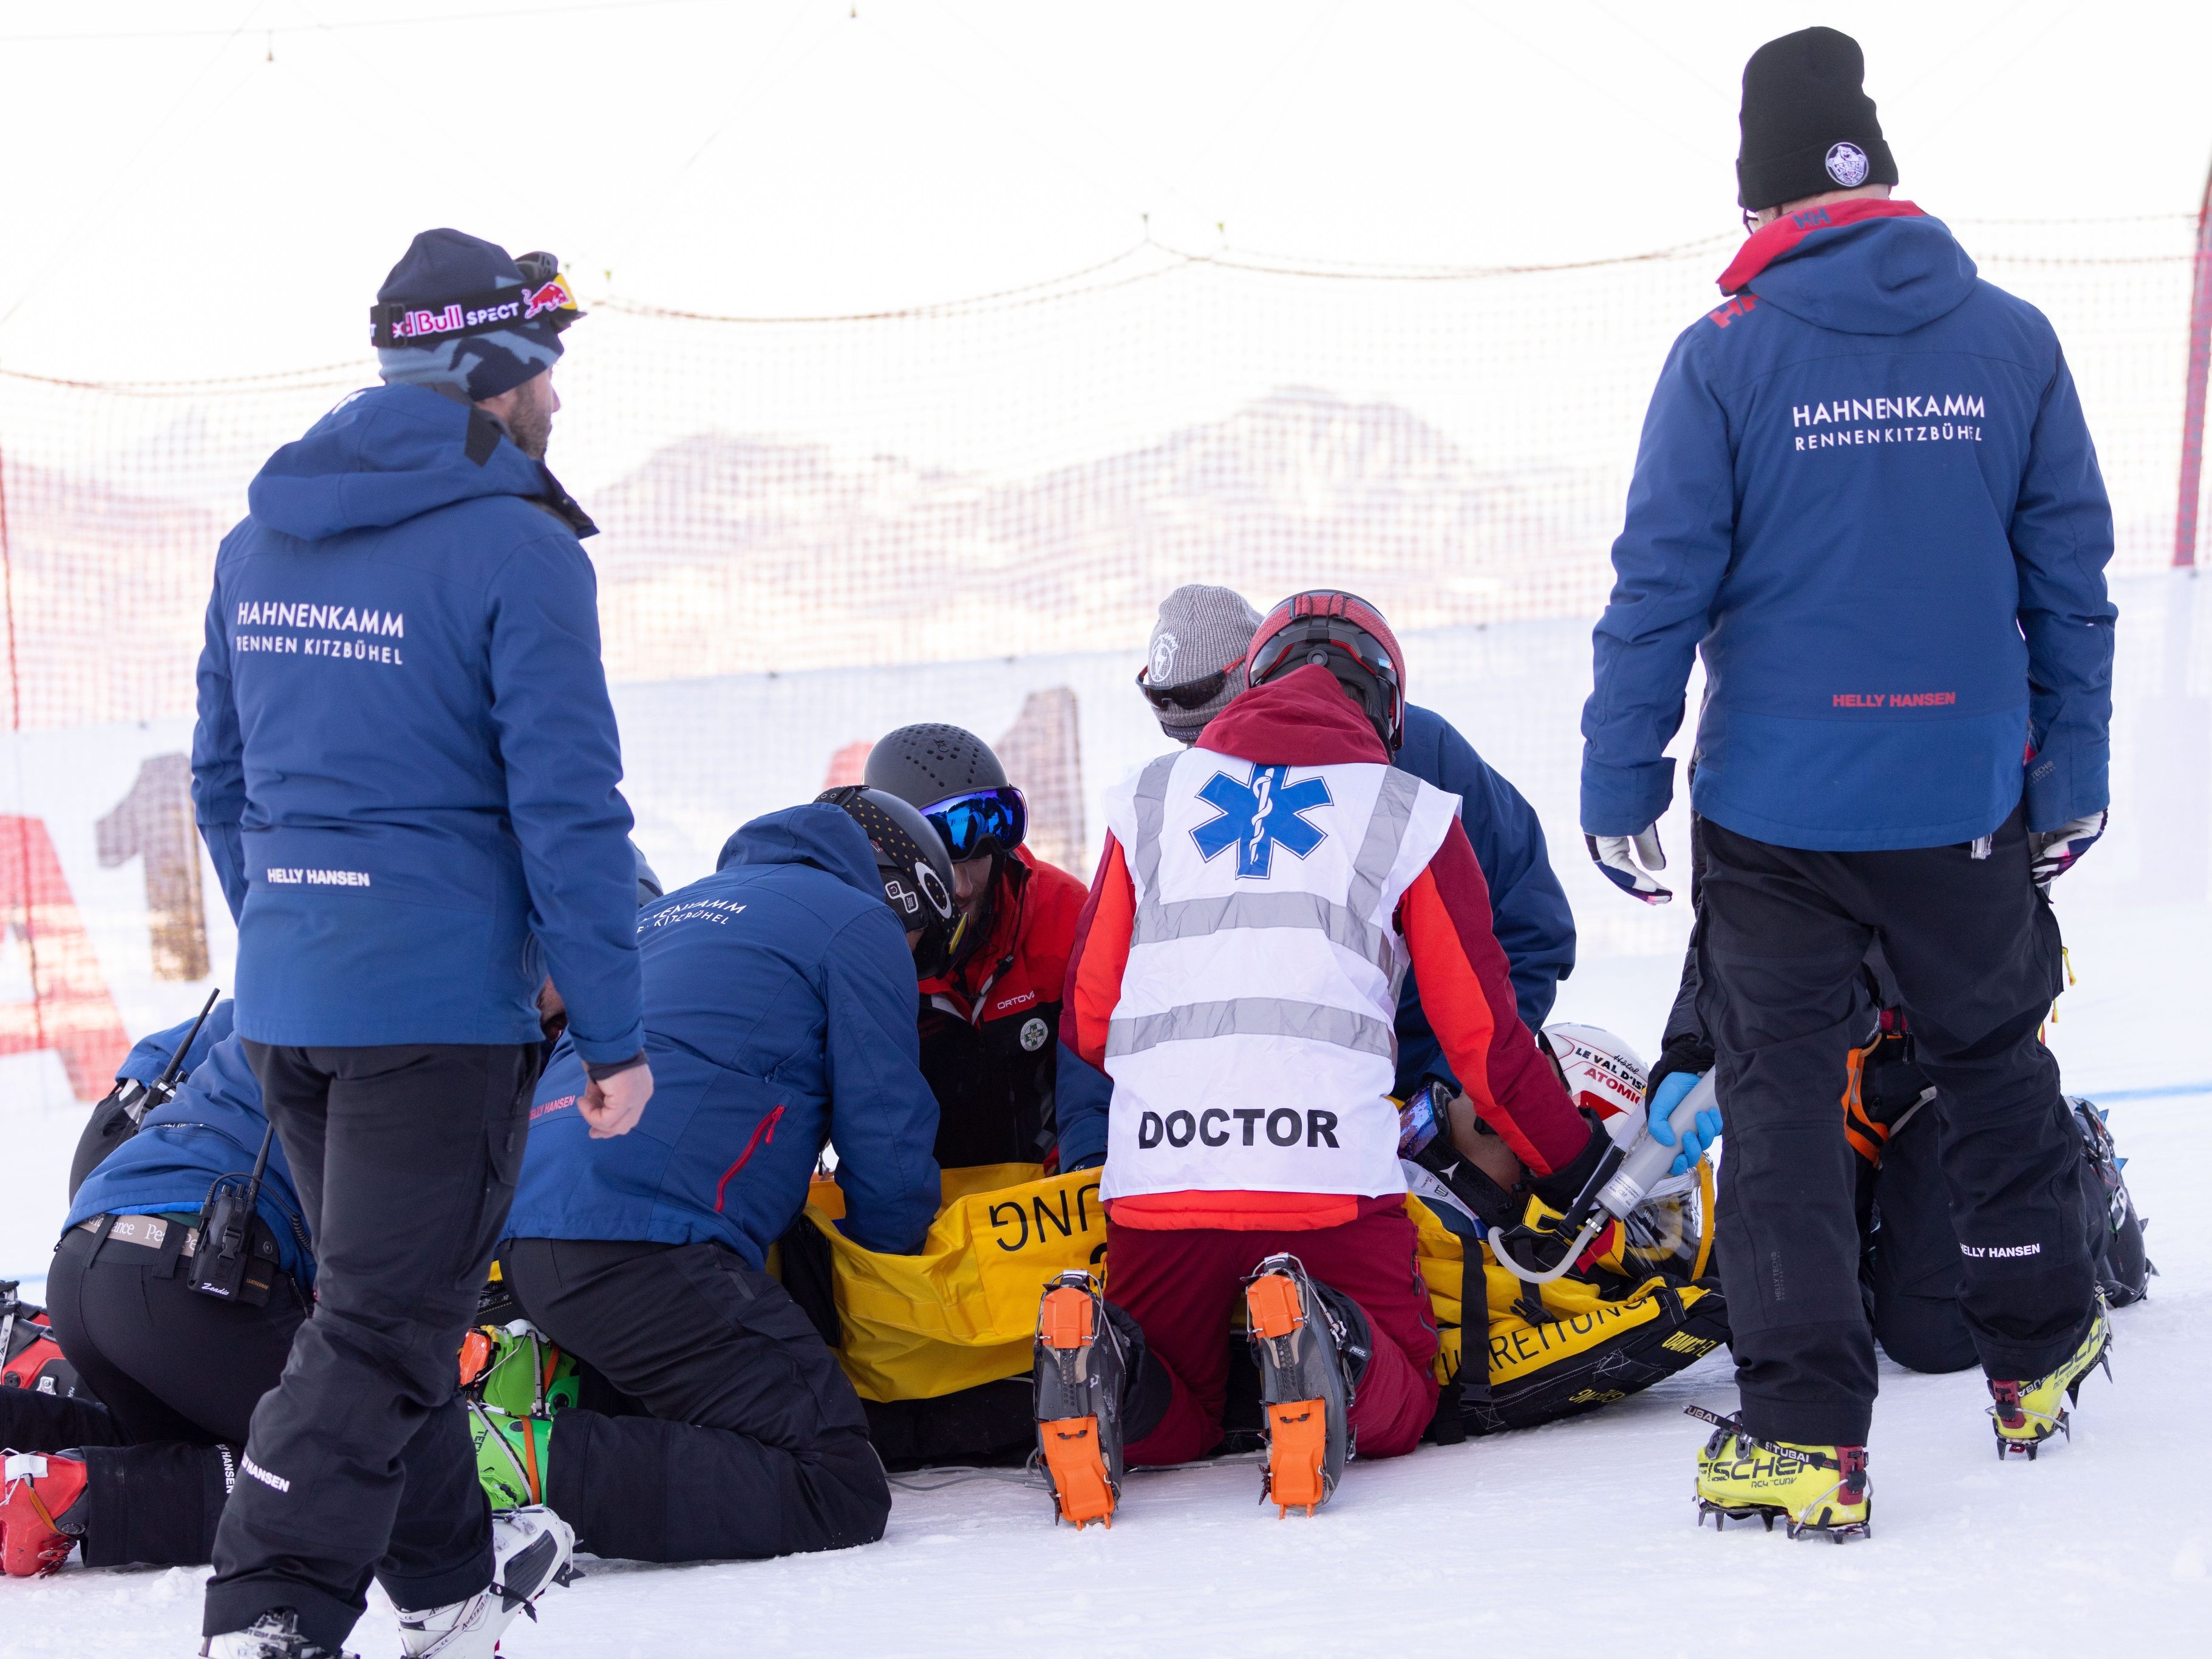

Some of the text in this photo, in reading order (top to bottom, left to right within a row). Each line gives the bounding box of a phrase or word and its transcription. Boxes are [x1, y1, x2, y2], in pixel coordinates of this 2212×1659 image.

[415, 304, 464, 336] Bull
[466, 302, 520, 325] SPECT
[1793, 394, 1985, 428] HAHNENKAMM
[237, 601, 404, 638] HAHNENKAMM
[236, 635, 403, 665] RENNEN KITZBÜHEL
[1833, 692, 1956, 707] HELLY HANSEN
[267, 868, 370, 887] HELLY HANSEN
[1575, 1048, 1591, 1060] LE
[1594, 1055, 1618, 1074] VAL
[1613, 1055, 1639, 1074] Hôtel
[544, 1095, 576, 1114] HANSEN
[1138, 1108, 1340, 1150] DOCTOR
[1959, 1242, 2040, 1258] HELLY HANSEN
[246, 1278, 269, 1290] LEATHERMAN
[1349, 1346, 1366, 1357] PETZL
[1687, 1406, 1718, 1424] UBAI
[246, 1460, 290, 1493] HANSEN
